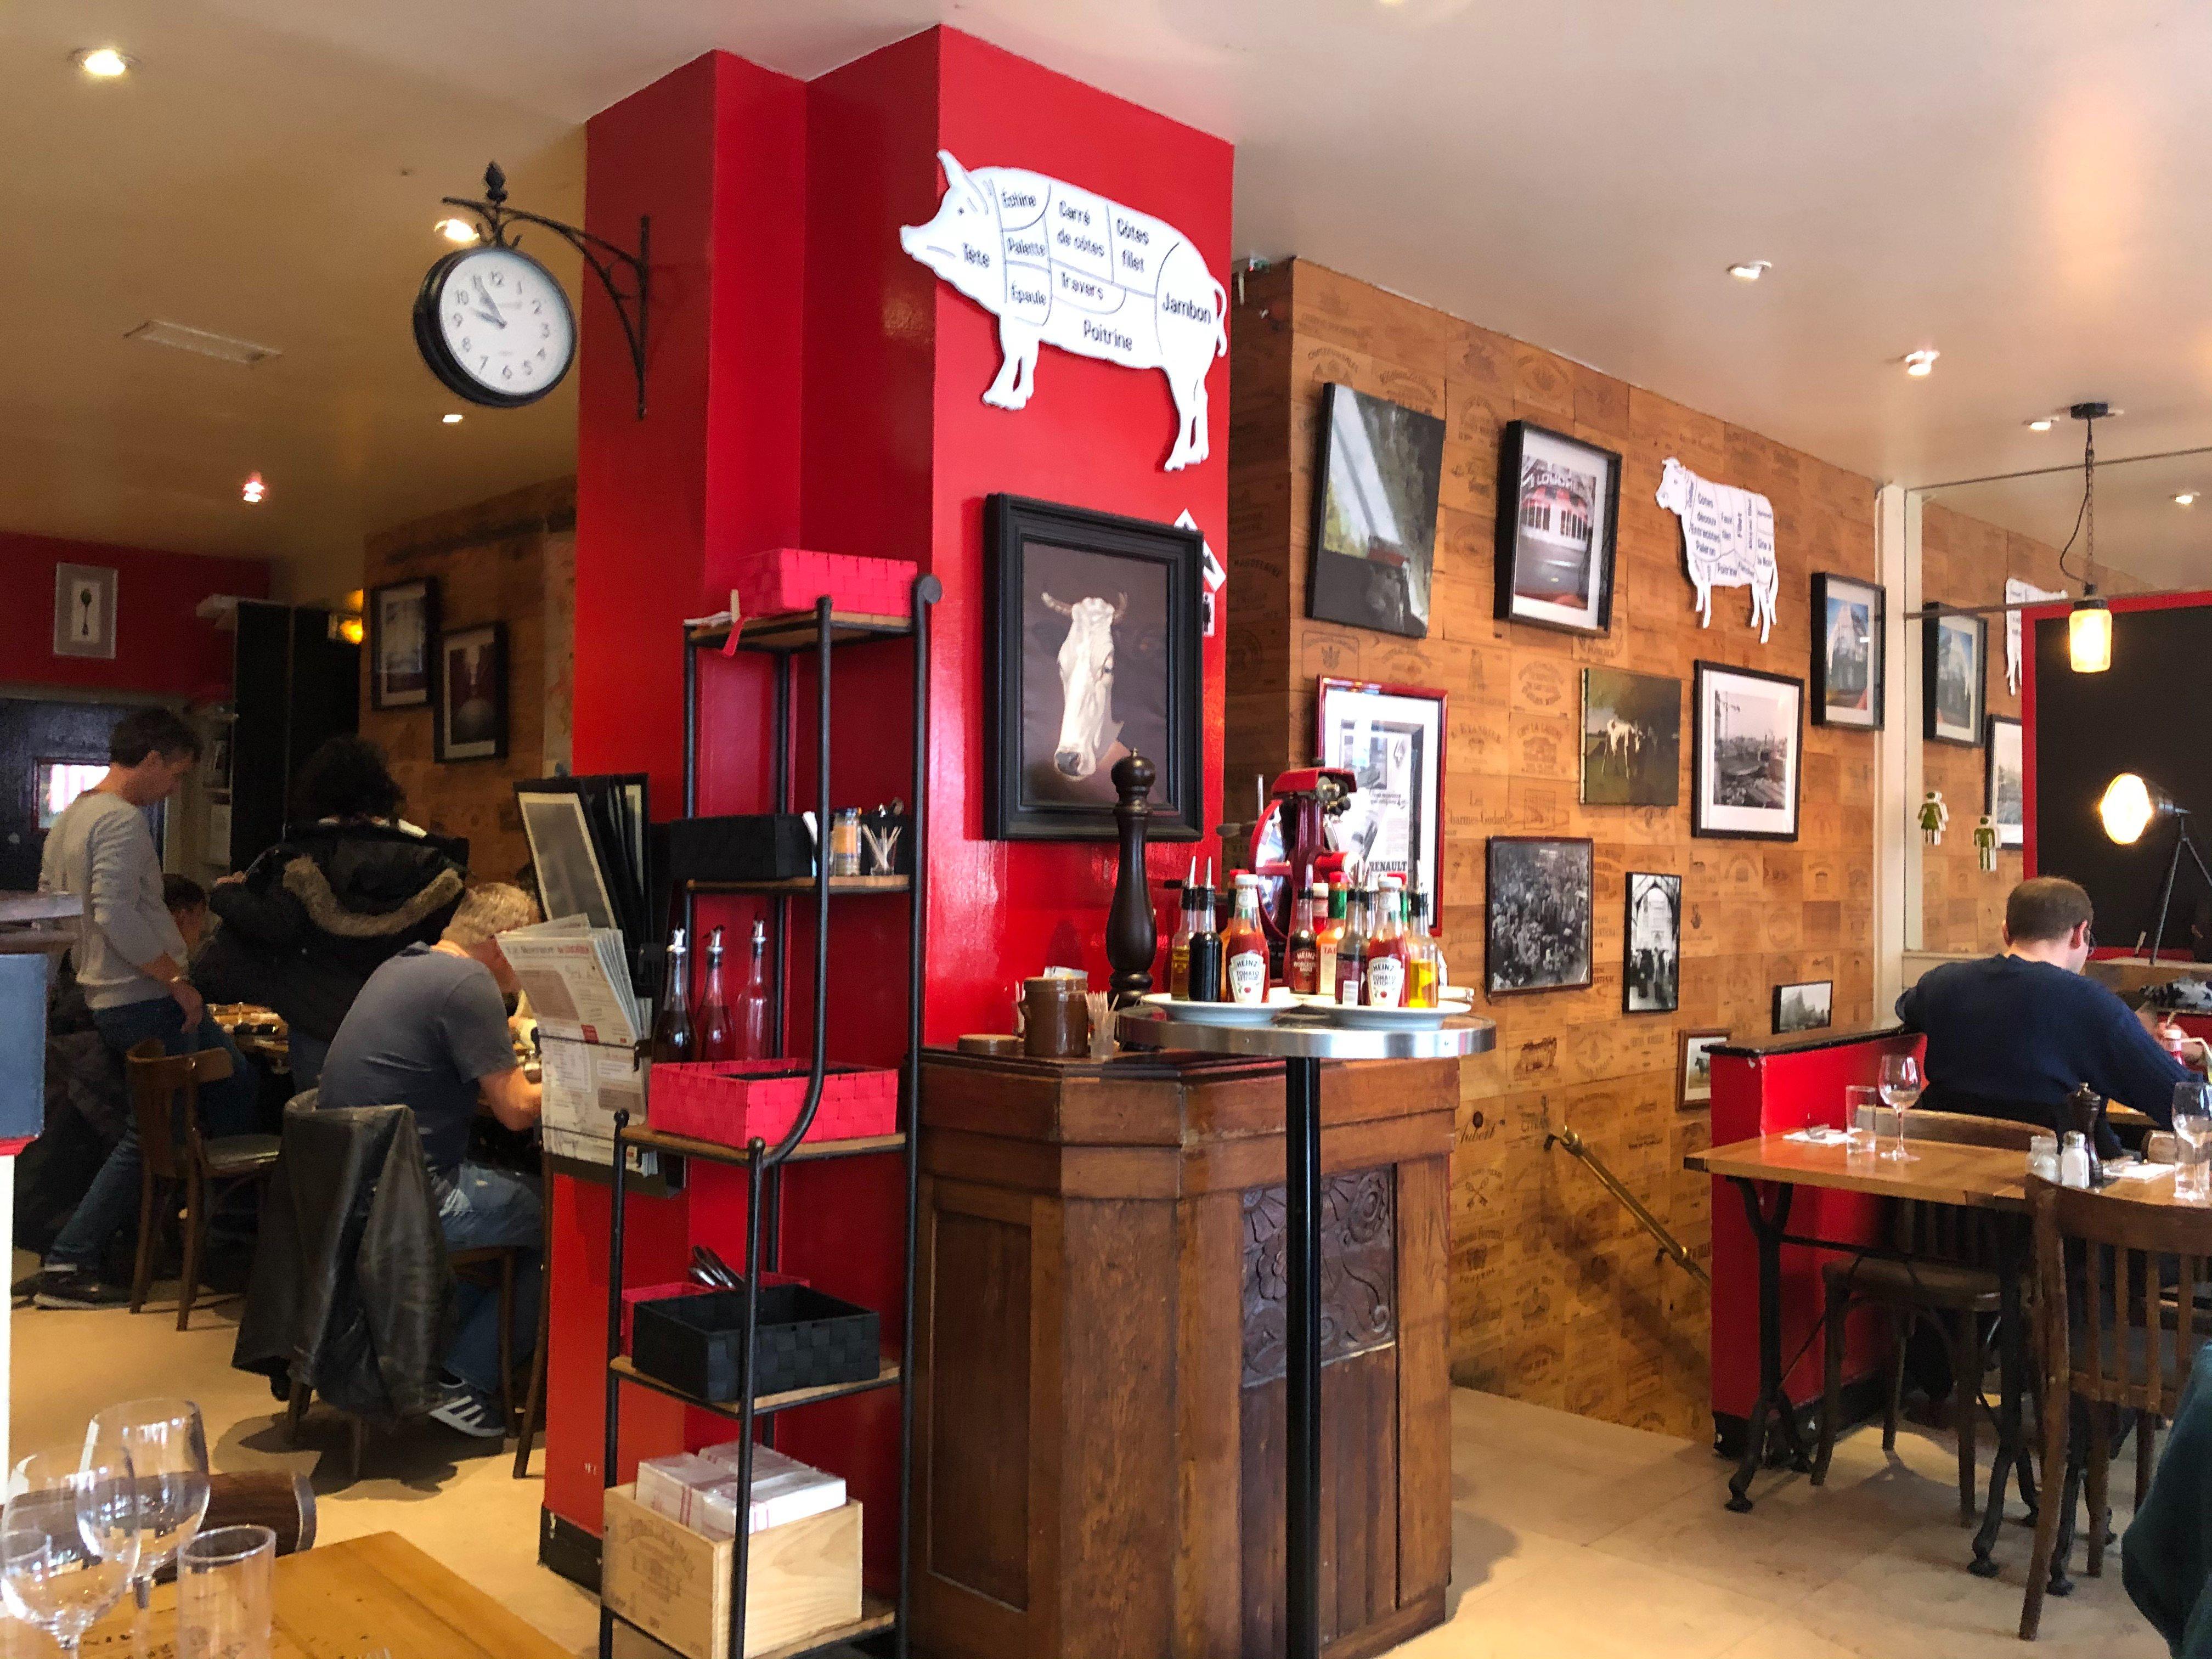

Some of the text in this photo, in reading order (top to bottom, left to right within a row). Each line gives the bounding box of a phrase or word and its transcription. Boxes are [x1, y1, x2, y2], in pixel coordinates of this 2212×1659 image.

[1058, 200, 1091, 225] Carré
[1057, 228, 1105, 258] de côtes
[1116, 218, 1150, 245] Côtes
[962, 242, 990, 268] Tête
[1007, 237, 1046, 257] Palette
[1122, 249, 1145, 273] filet
[1011, 280, 1047, 308] Épaule
[1060, 272, 1104, 301] Travers
[1161, 293, 1212, 325] Jambon
[1084, 319, 1133, 352] Poitrine
[1369, 860, 1407, 872] RENAULT
[1237, 960, 1258, 968] HEINZ
[1296, 951, 1316, 960] HEINZ
[1373, 963, 1395, 972] HEINZ
